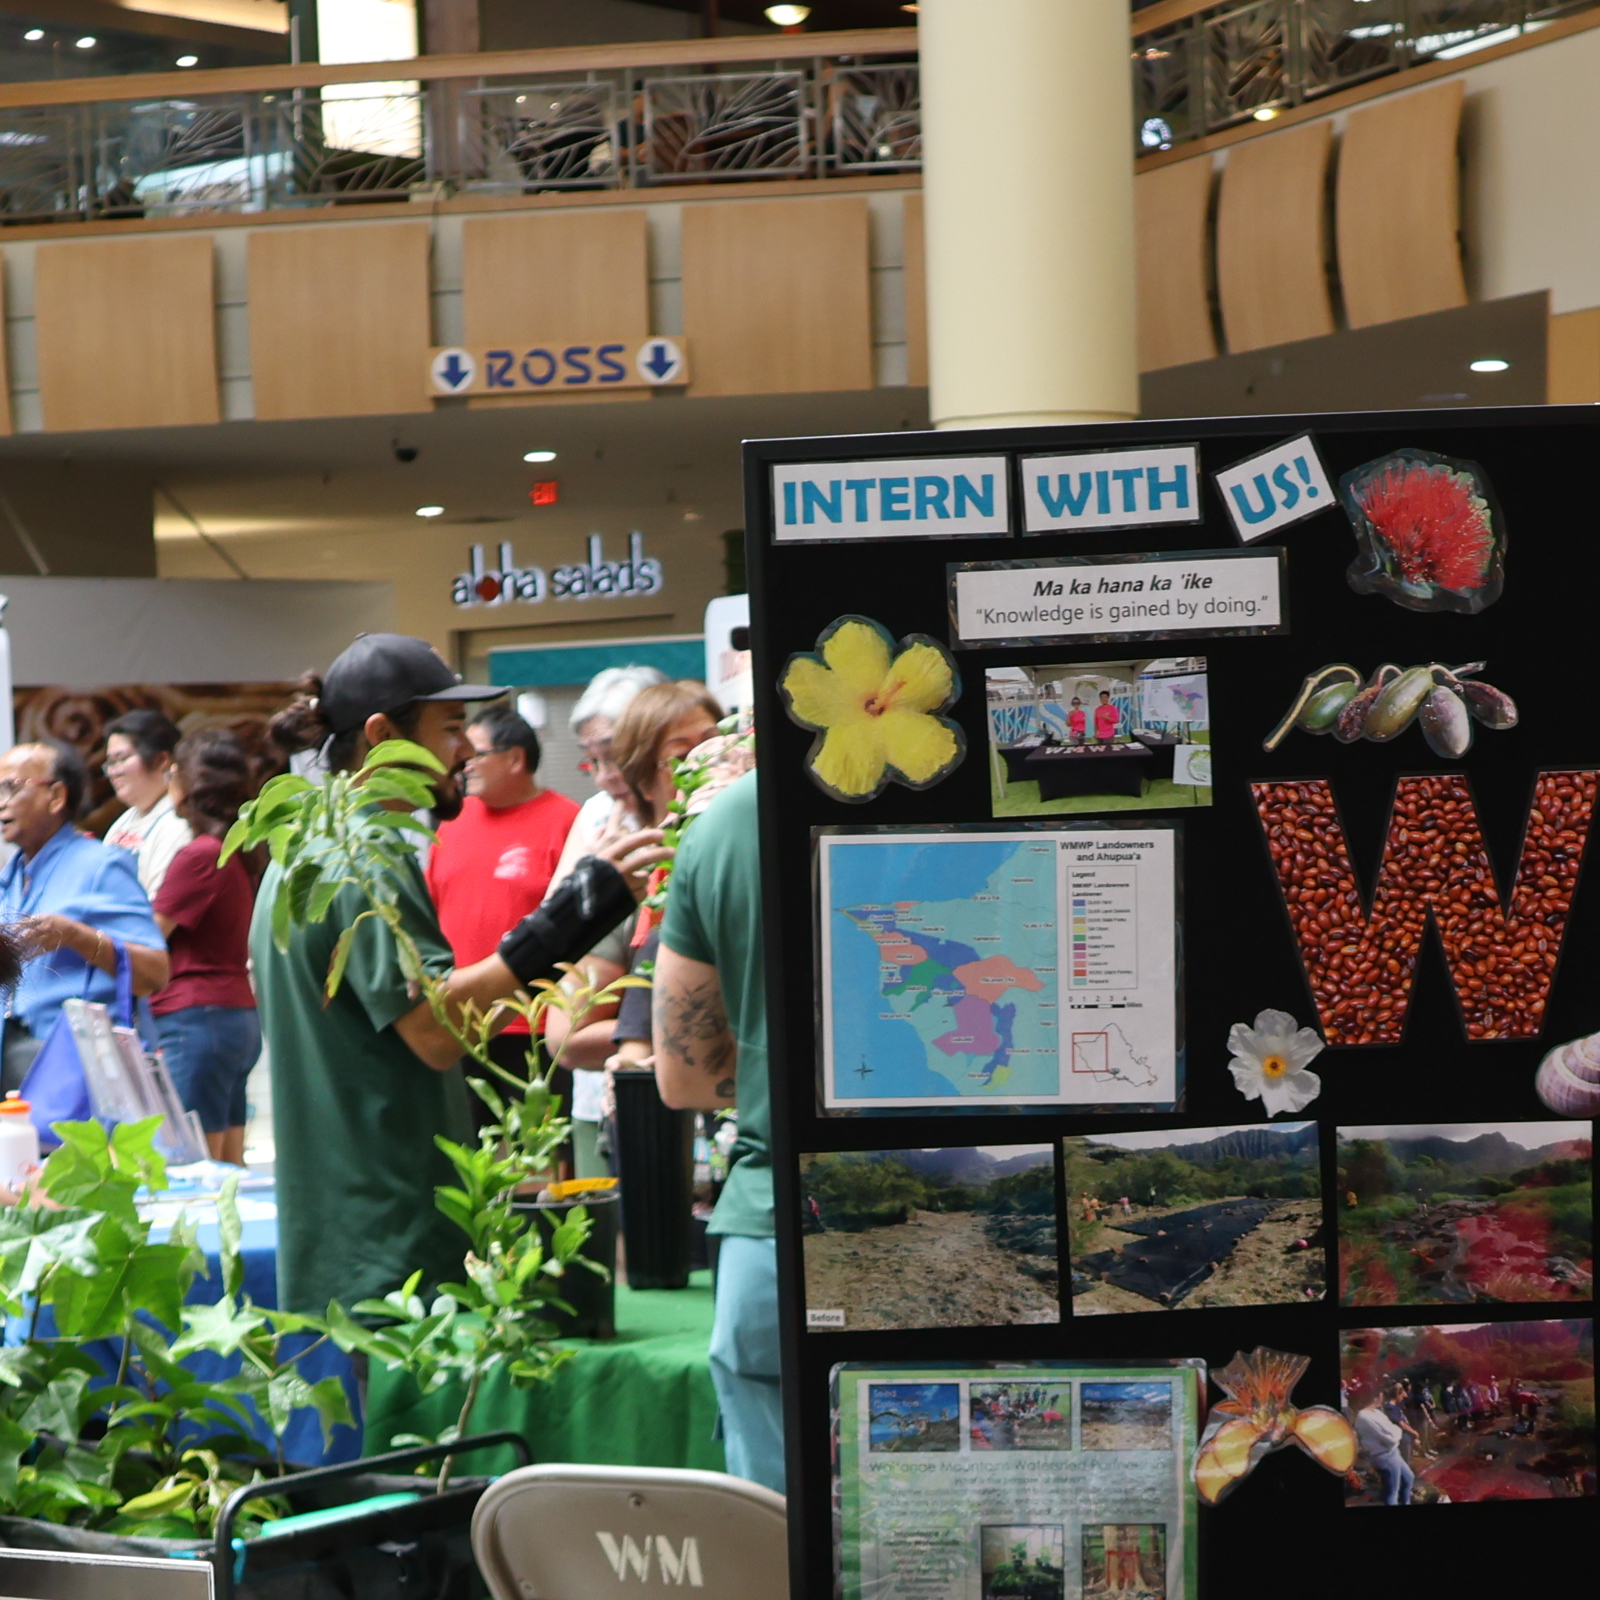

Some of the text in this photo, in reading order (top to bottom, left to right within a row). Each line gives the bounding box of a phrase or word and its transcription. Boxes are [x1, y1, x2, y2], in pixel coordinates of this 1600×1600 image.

[485, 344, 626, 387] ROSS
[783, 456, 1319, 525] INTERN WITH US!
[453, 530, 663, 608] aloha salads
[1033, 580, 1063, 597] Ma
[1069, 578, 1092, 595] ka
[1097, 577, 1144, 594] hana
[1150, 575, 1172, 591] ka
[1090, 603, 1103, 619] is
[1109, 600, 1170, 621] gained
[1177, 599, 1198, 618] by
[1077, 853, 1094, 861] and
[1097, 840, 1154, 850] Landowners
[597, 1531, 704, 1588] WM
